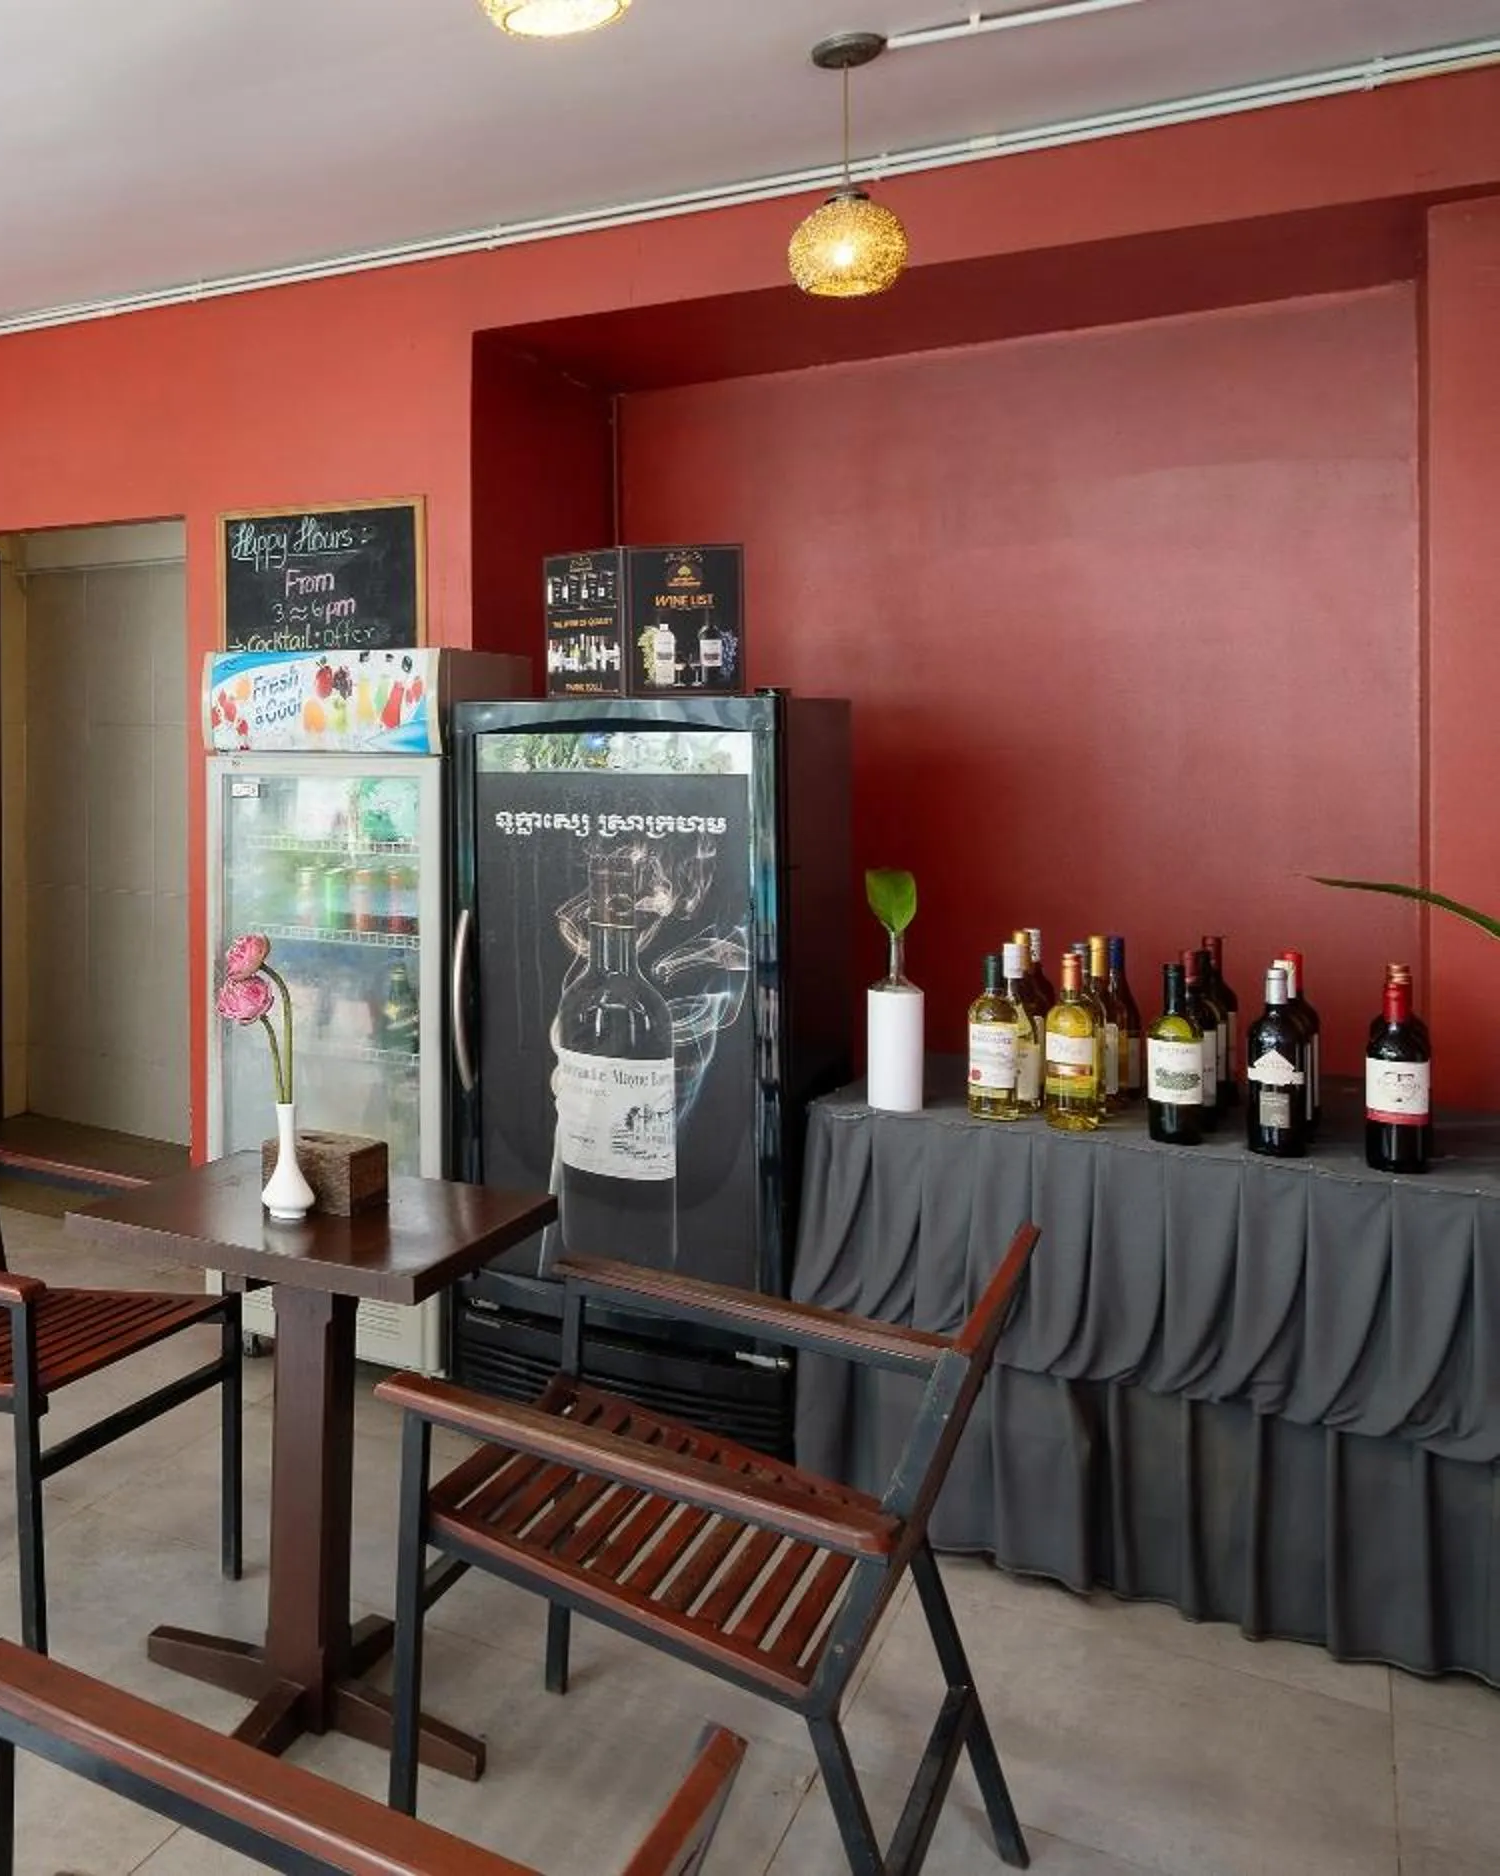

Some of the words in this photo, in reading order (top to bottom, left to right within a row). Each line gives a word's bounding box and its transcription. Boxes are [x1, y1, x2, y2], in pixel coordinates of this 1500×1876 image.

[284, 569, 335, 598] From
[655, 594, 688, 607] WINE
[691, 593, 714, 606] LIST
[253, 666, 299, 701] Fresh
